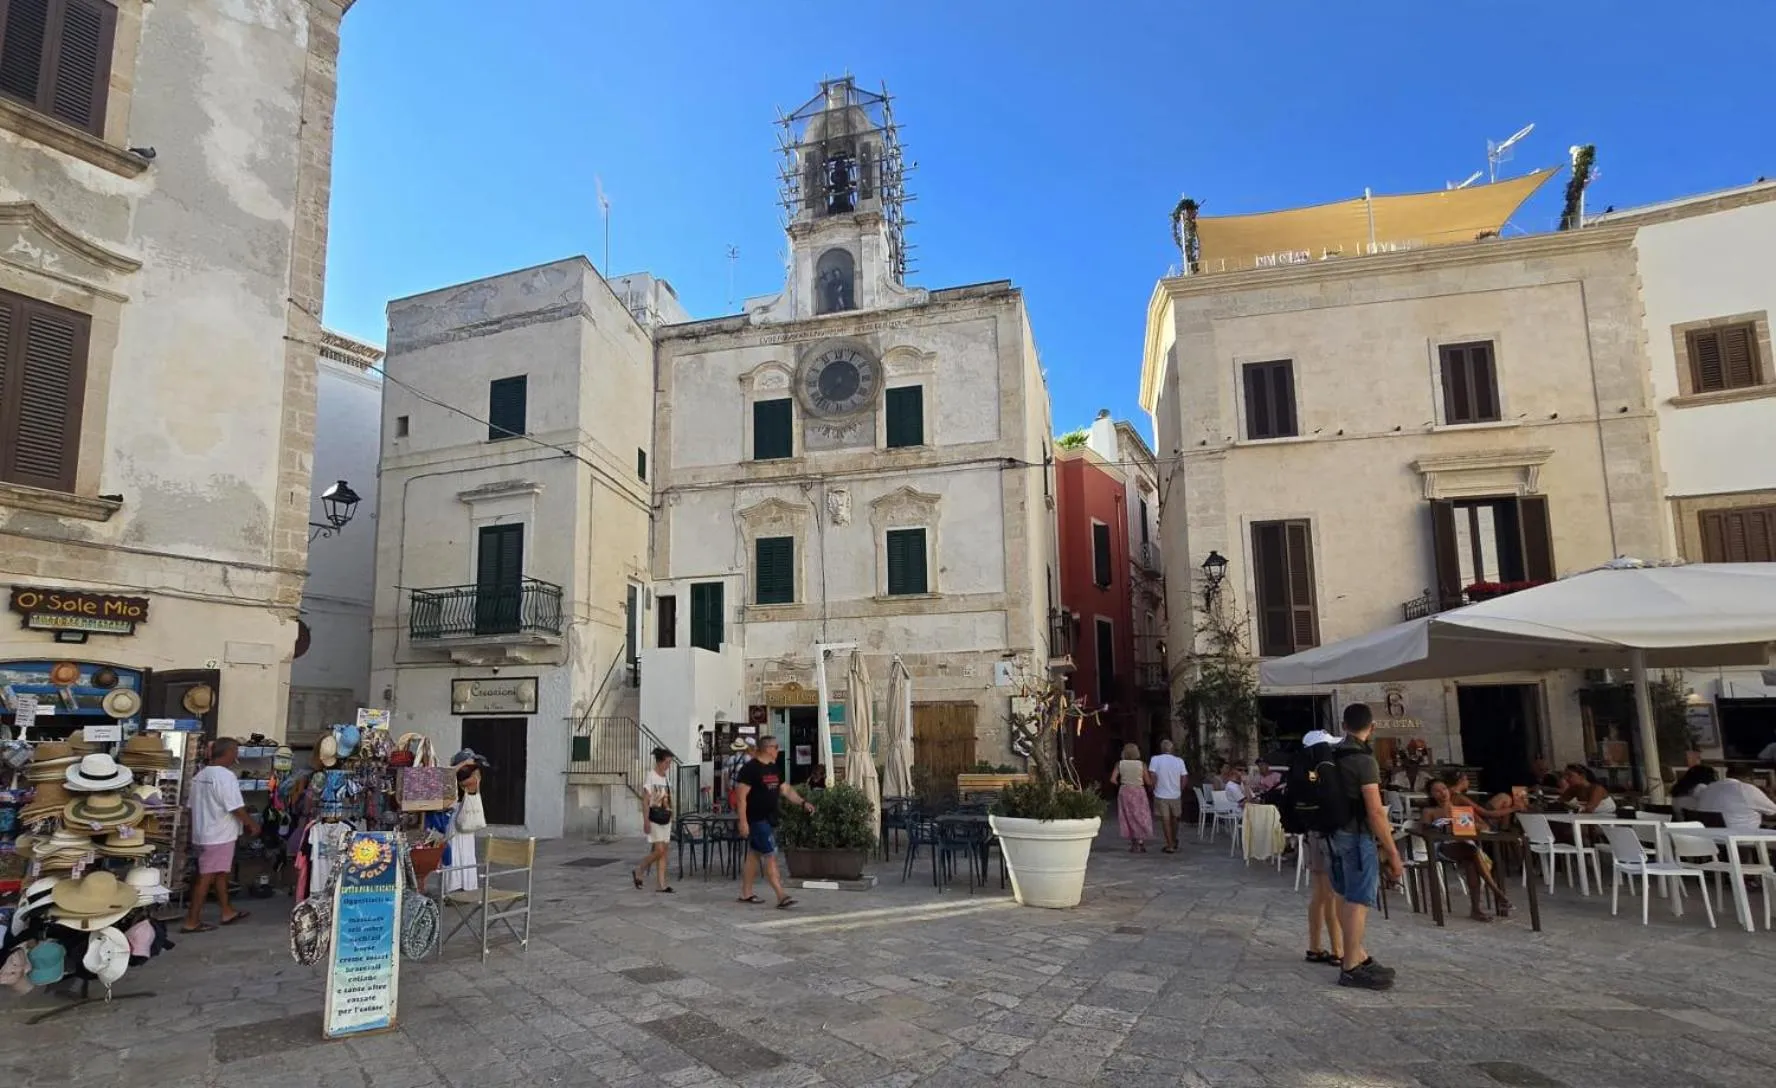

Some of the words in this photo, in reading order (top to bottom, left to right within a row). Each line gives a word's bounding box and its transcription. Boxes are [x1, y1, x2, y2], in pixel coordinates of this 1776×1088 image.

[18, 592, 43, 607] O'
[47, 594, 97, 615] Sole
[104, 600, 140, 616] Mio
